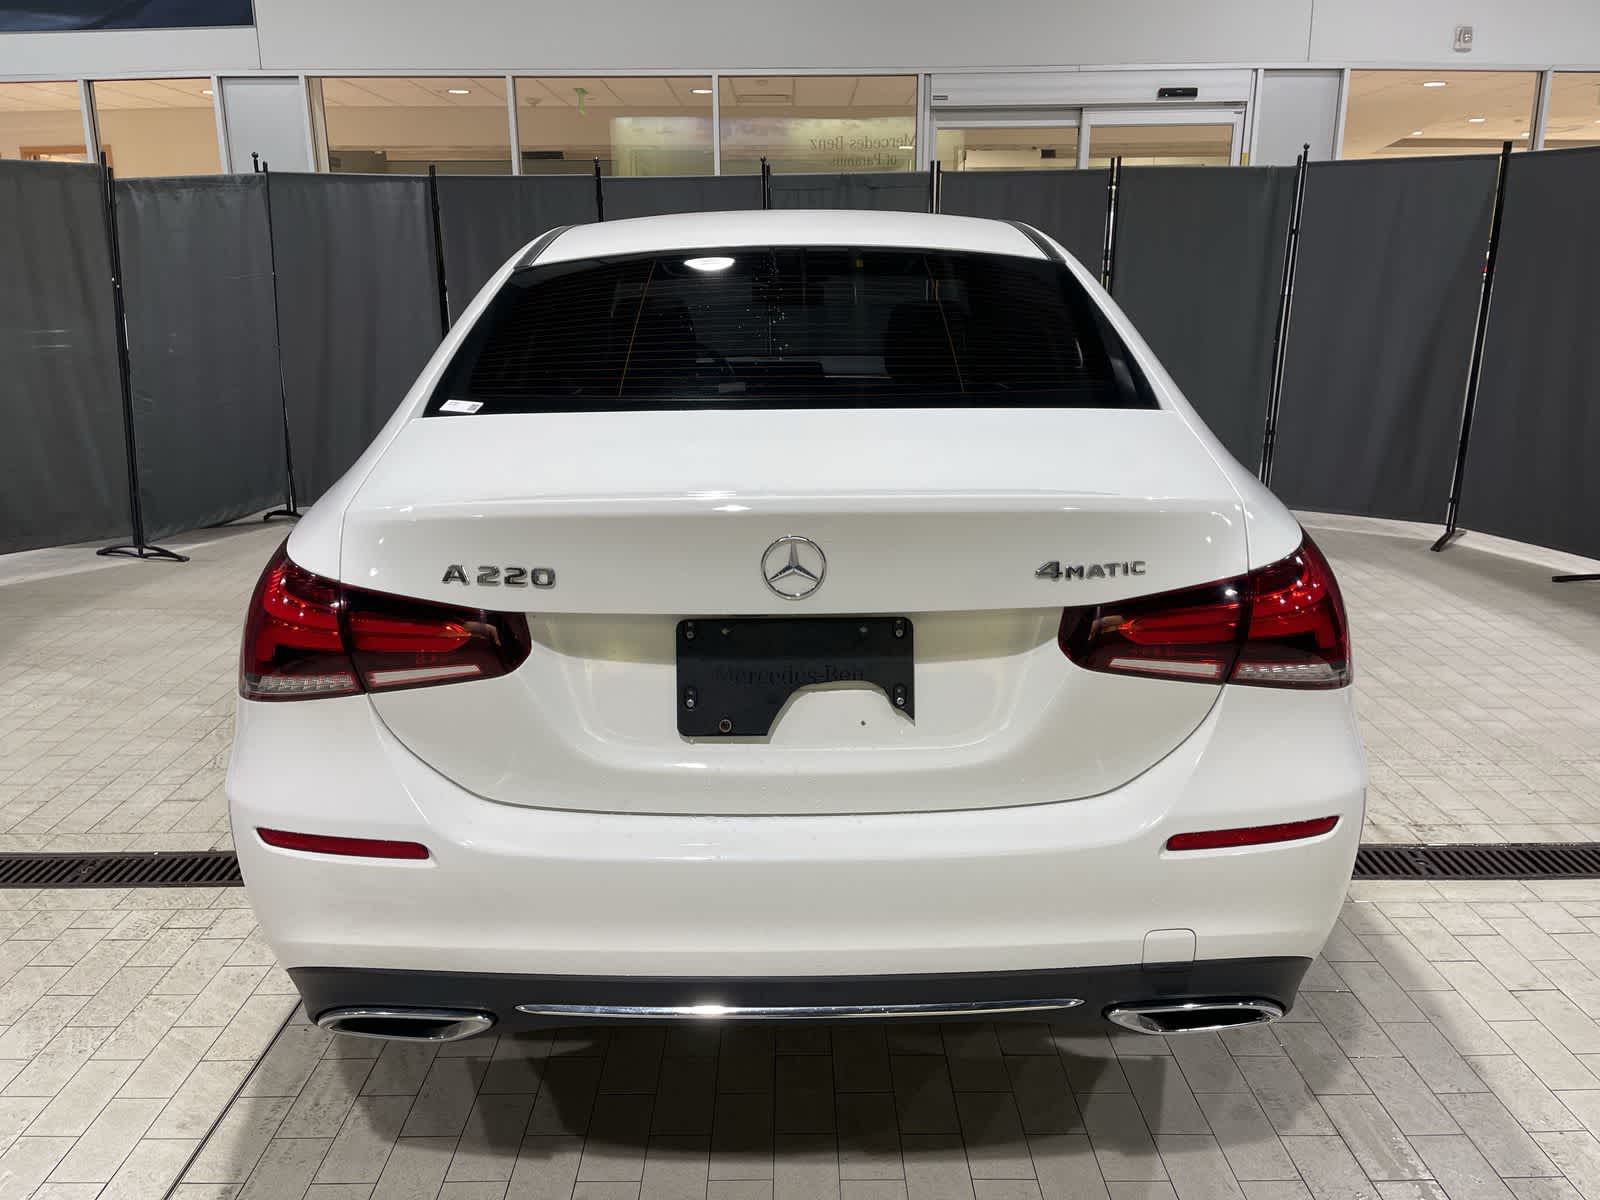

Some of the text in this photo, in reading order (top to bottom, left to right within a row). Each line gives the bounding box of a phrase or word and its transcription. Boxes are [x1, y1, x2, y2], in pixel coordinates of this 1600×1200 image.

[442, 564, 556, 590] A 220
[1034, 560, 1147, 582] 4MATIC
